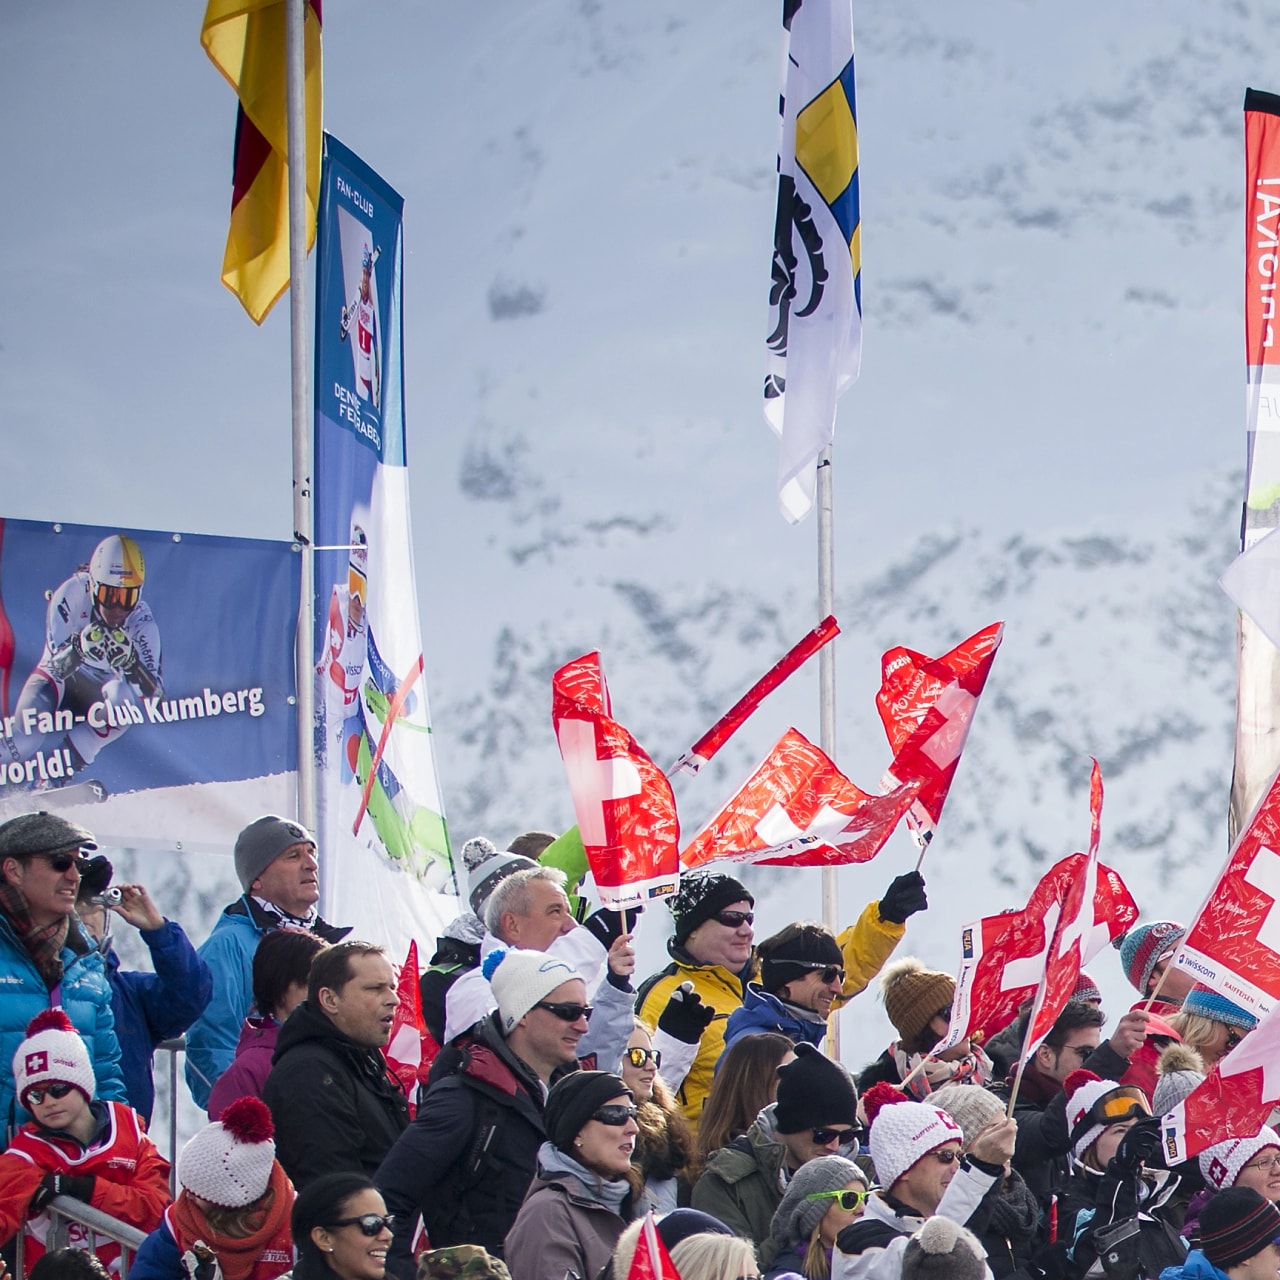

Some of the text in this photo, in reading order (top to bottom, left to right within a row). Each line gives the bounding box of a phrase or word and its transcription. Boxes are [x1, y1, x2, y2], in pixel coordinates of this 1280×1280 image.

[337, 177, 374, 218] FAN-CLUB
[22, 699, 146, 736] Fan-Club
[144, 687, 265, 725] Kumberg
[1184, 956, 1256, 1005] swisscom RAIFFEISEN
